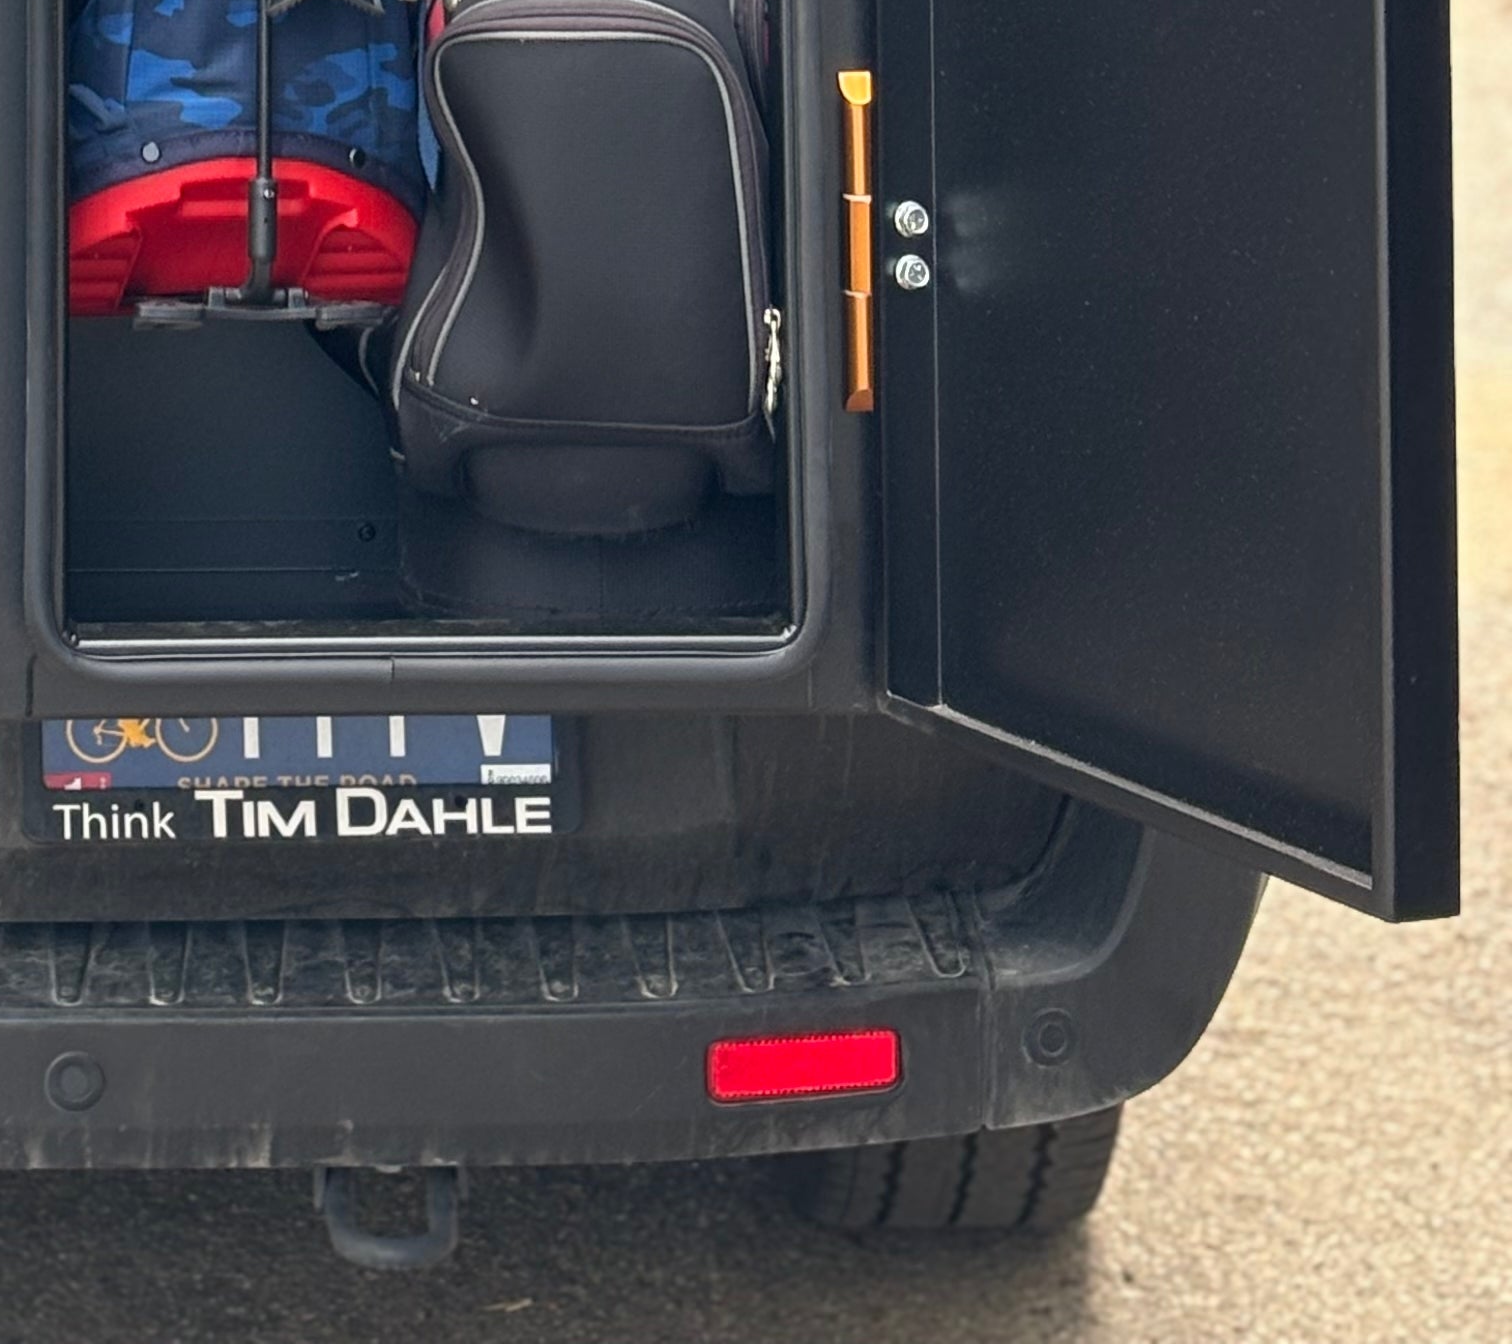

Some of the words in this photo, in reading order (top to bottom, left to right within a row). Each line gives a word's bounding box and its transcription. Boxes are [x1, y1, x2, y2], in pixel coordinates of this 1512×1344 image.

[52, 797, 177, 841] Think
[193, 789, 318, 839] TIM
[335, 786, 553, 838] DAHLE
